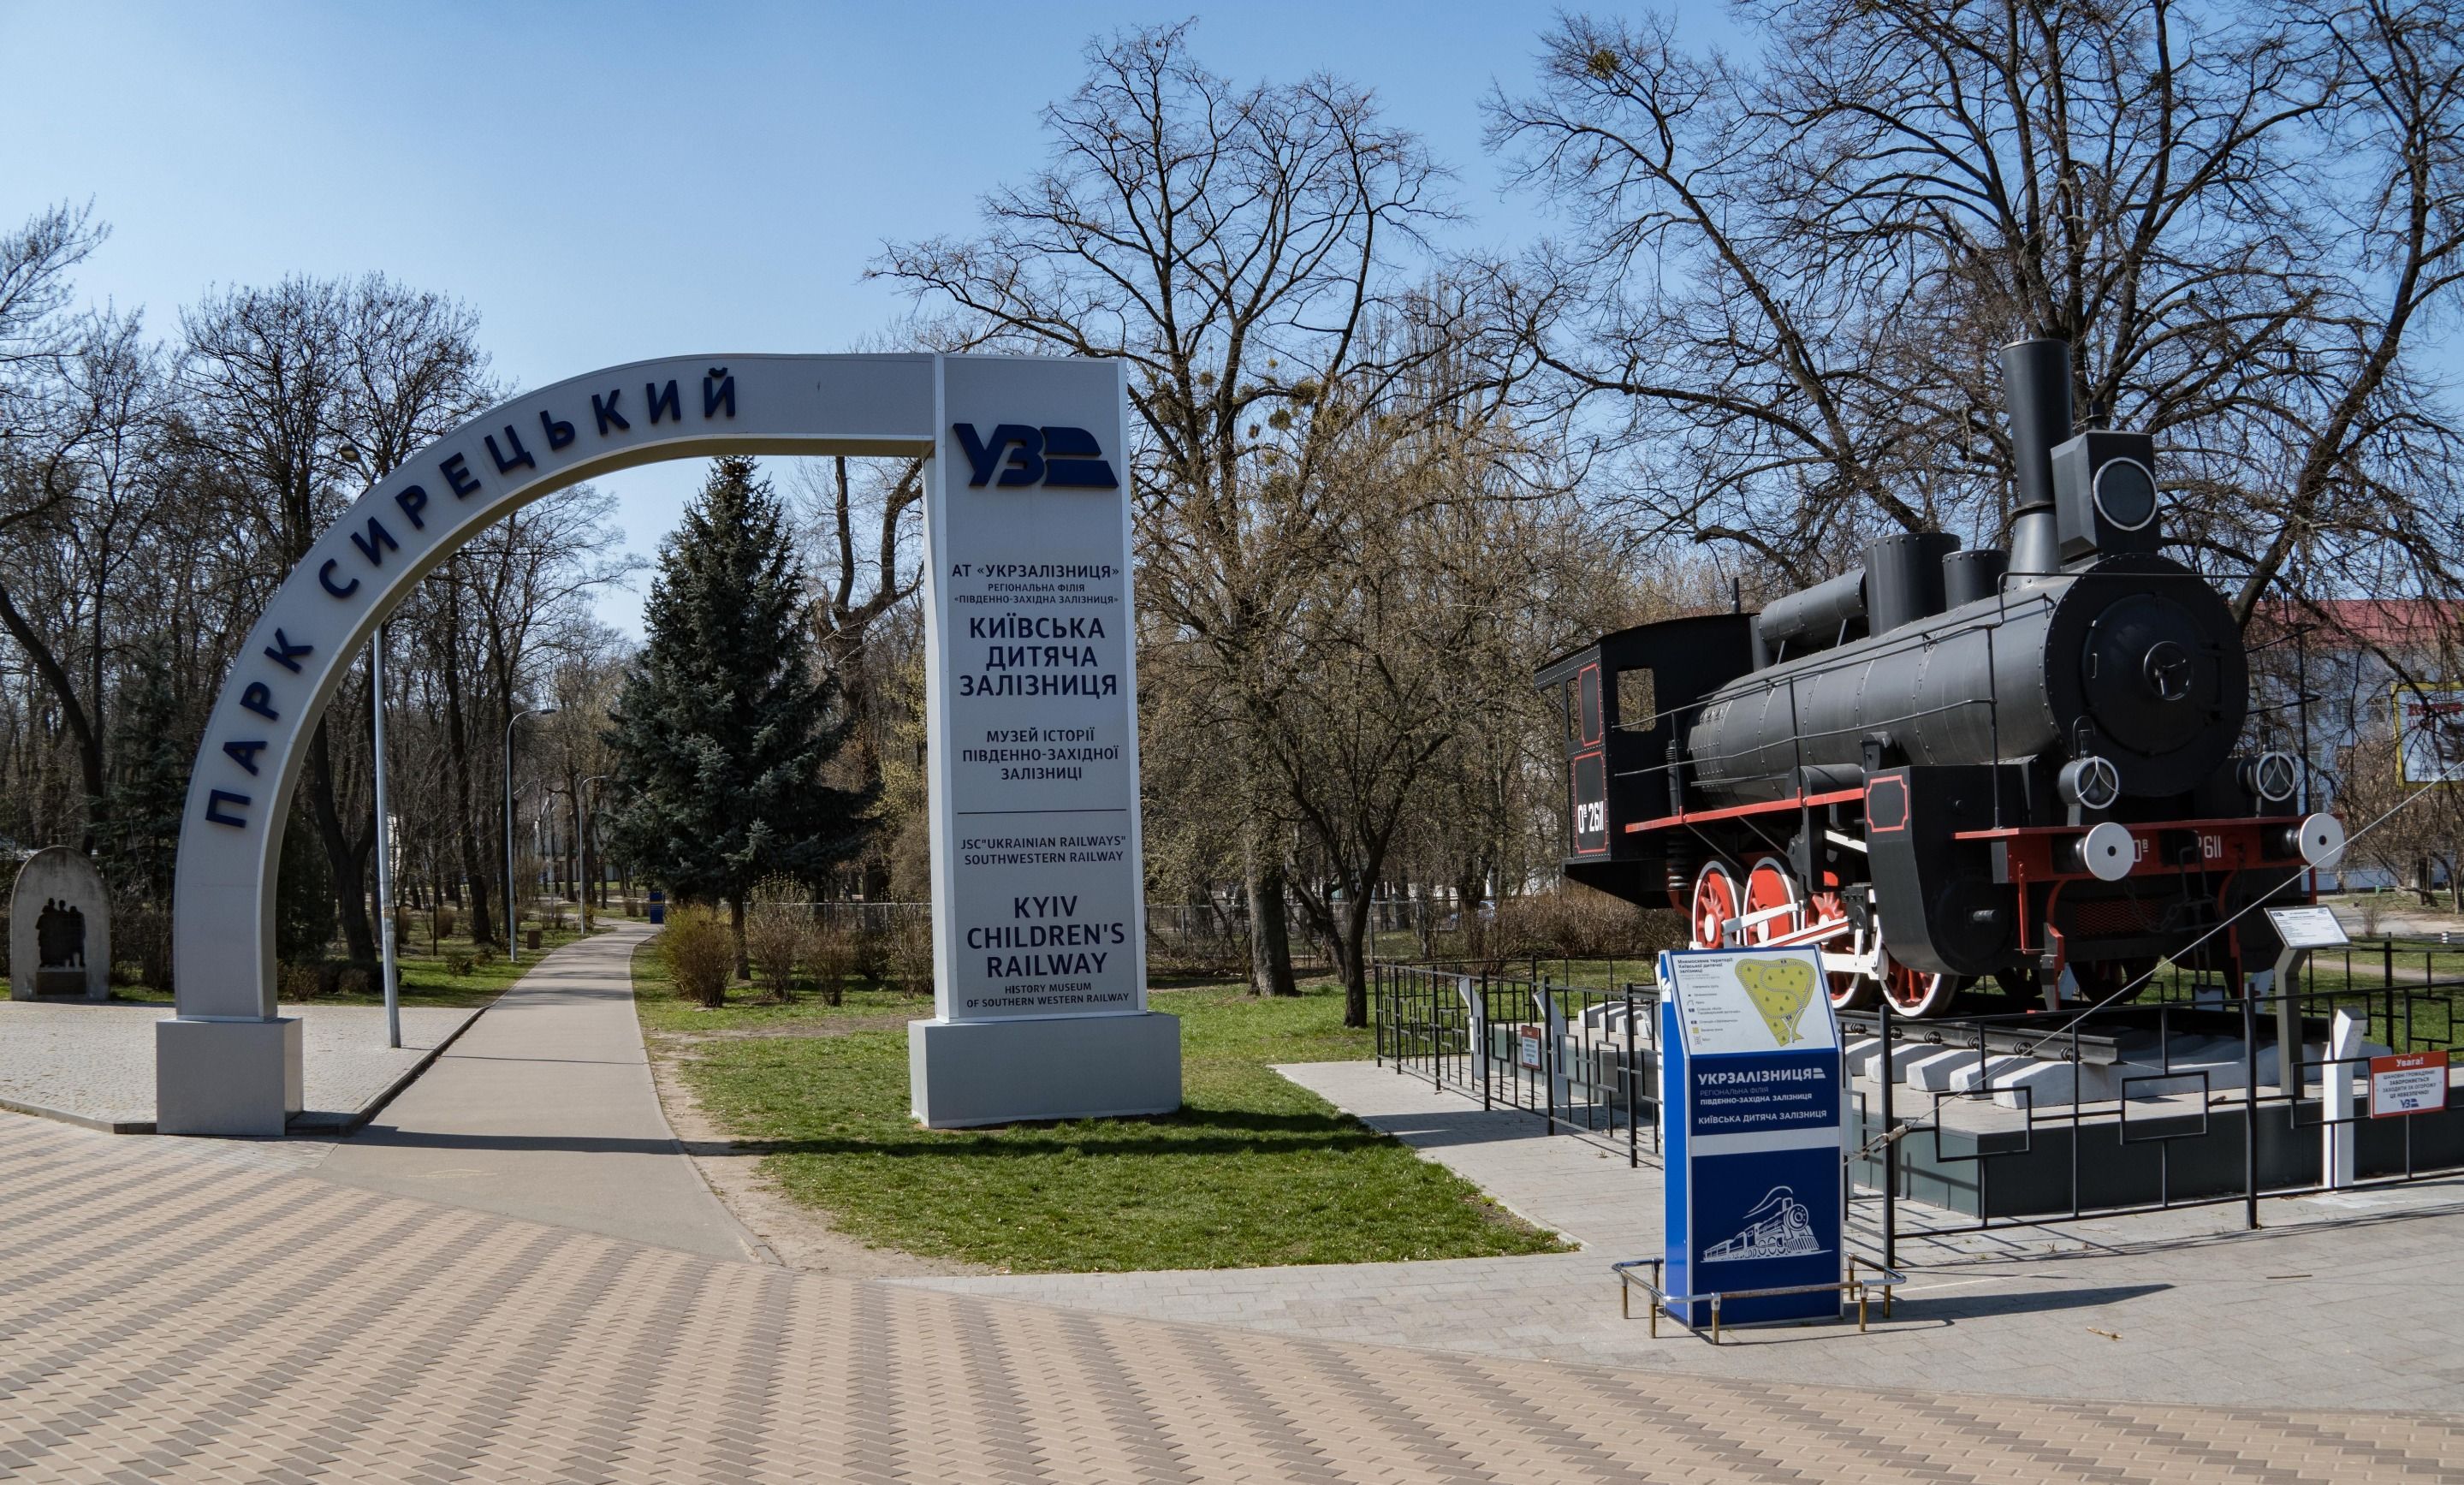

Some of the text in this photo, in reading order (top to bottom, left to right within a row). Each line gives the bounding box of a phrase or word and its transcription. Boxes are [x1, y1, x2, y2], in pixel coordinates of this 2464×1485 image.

[952, 564, 1119, 580] АТ «УКРЗАЛІЗНИЦЯ»
[988, 583, 1085, 592] РЕГІОНАЛЬНА ФІЛІЯ
[205, 367, 736, 829] ПАРК СИРЕЦЬКИЙ
[970, 613, 1105, 639] КИЇВСЬКА
[986, 645, 1098, 671] ДИТЯЧА
[959, 674, 1117, 699] ЗАЛІЗНИЦЯ
[986, 727, 1095, 742] МУЗЕЙ ІСТОРІЇ
[963, 745, 1119, 763] ПІВДЕННО-ЗАХІДНОЇ
[1000, 767, 1082, 781] ЗАЛІЗНИЦІ
[1588, 800, 1604, 832] 2611
[1060, 836, 1126, 848] RAILWAYS"
[965, 852, 1124, 865] SOUTHWESTERN RAILWAY
[1013, 895, 1078, 919] KYIV
[967, 923, 1125, 950] CHILDREN'S
[987, 952, 1108, 978] RAILWAY
[1005, 982, 1091, 995] HISTORY MUSEUM
[966, 993, 1129, 1008] OF SOUTHERN WESTERN RAILWAY
[2396, 1057, 2424, 1067] Увага!
[1698, 1068, 1812, 1085] УКРЗАЛІЗНИЦЯ
[1700, 1088, 1749, 1096] РЕГІОНАЛЬНА
[1700, 1093, 1813, 1106] ПІВДЕННО-ЗАХІДНА ЗАЛІЗНИЦЯ
[1698, 1110, 1827, 1125] КИЇВСЬКА ДИТЯЧА ЗАЛІЗНИЦЯ
